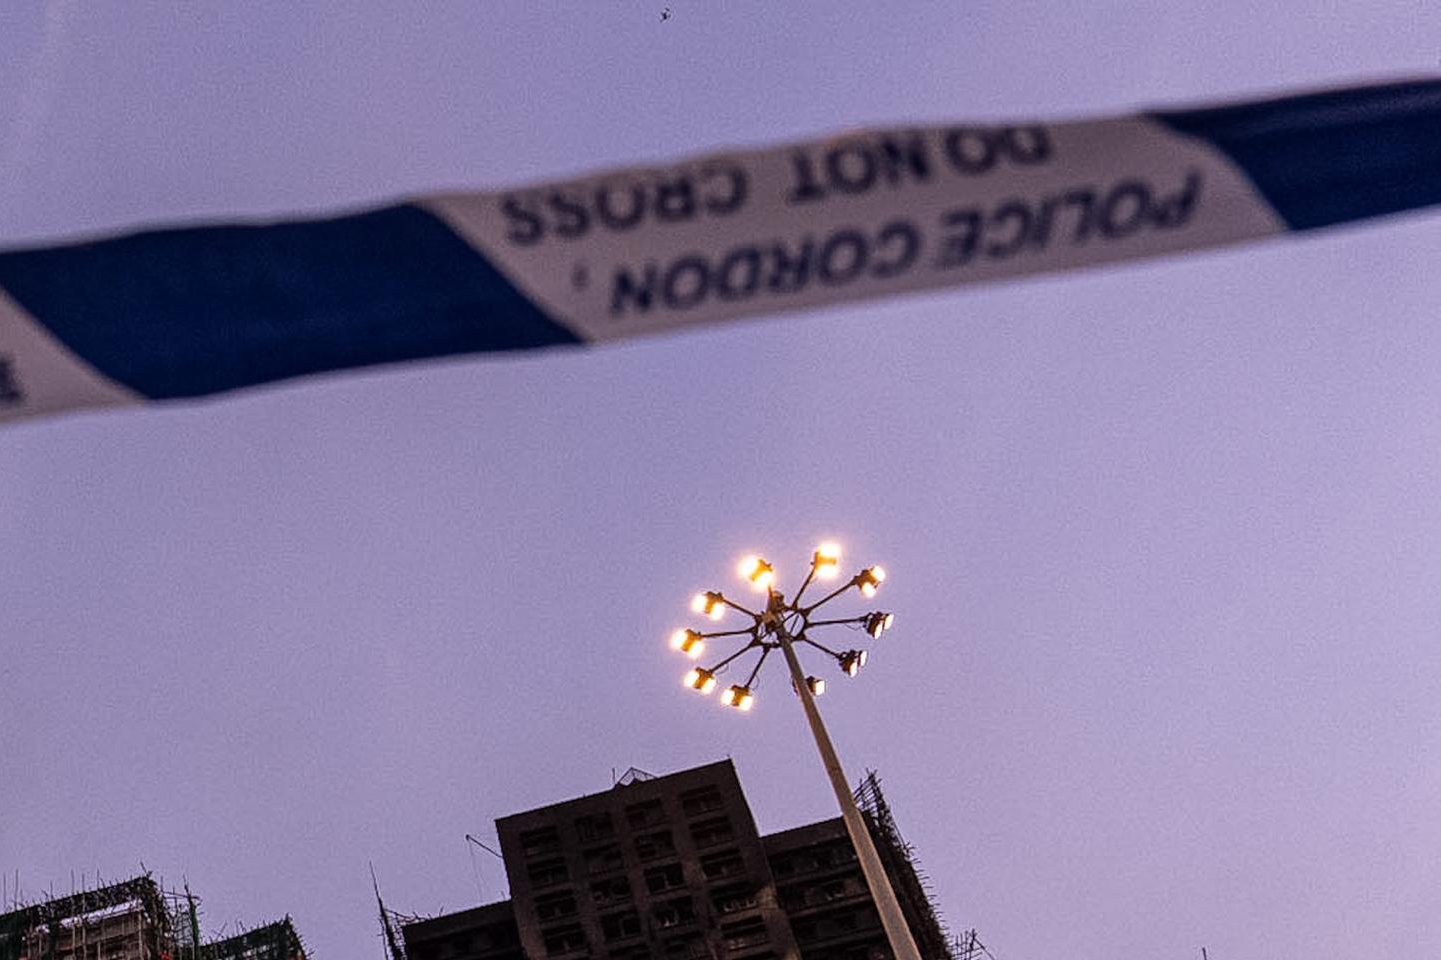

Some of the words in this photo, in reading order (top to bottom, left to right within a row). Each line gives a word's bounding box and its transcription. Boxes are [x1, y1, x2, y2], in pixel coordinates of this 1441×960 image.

[782, 133, 929, 205] NOT
[945, 122, 1051, 176] DO
[499, 158, 749, 246] CROSS
[933, 165, 1202, 270] POLICE
